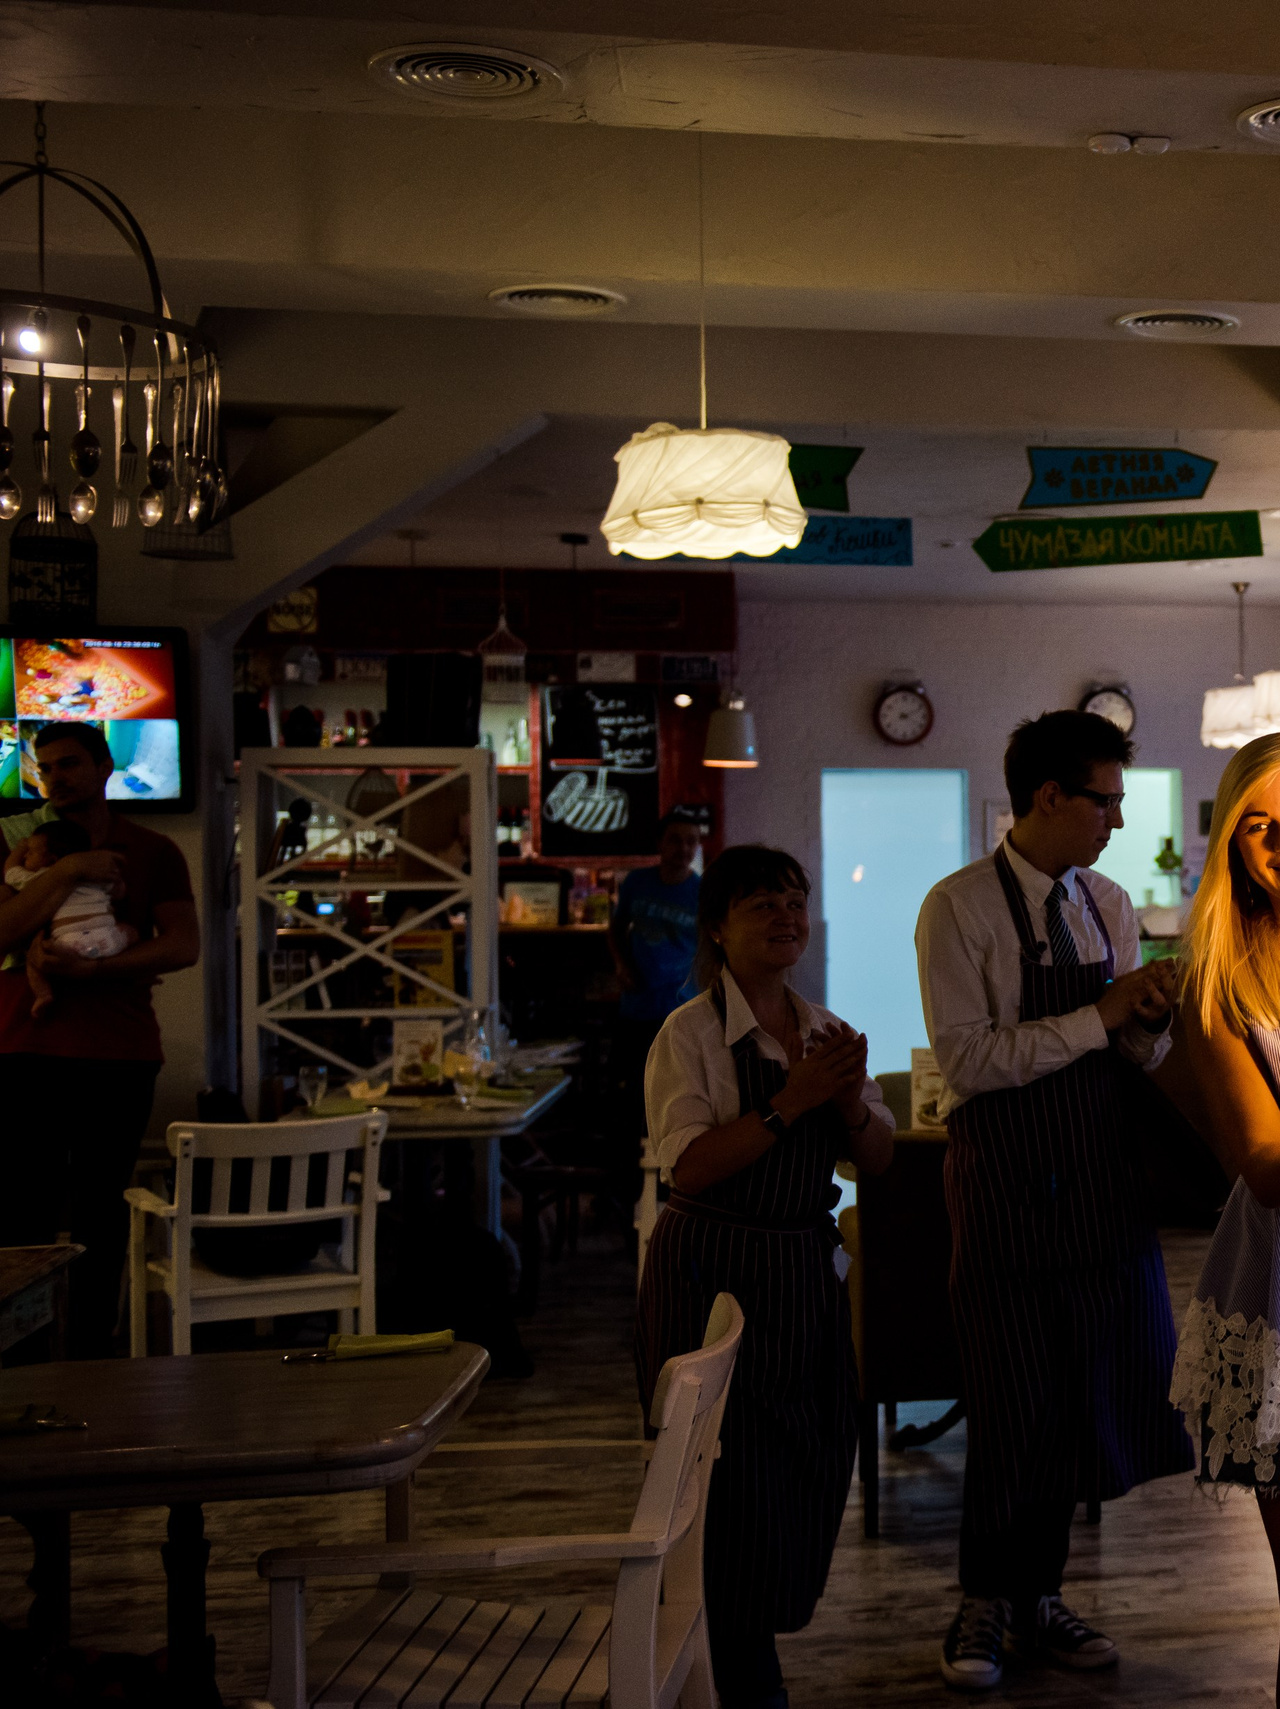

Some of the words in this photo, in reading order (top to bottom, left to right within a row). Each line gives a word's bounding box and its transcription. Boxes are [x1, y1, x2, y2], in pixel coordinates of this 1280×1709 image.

[1070, 474, 1177, 498] ВЕРАНДА
[999, 524, 1115, 564] ЧУМАЗАЯ
[1119, 519, 1237, 557] КОМНАТА
